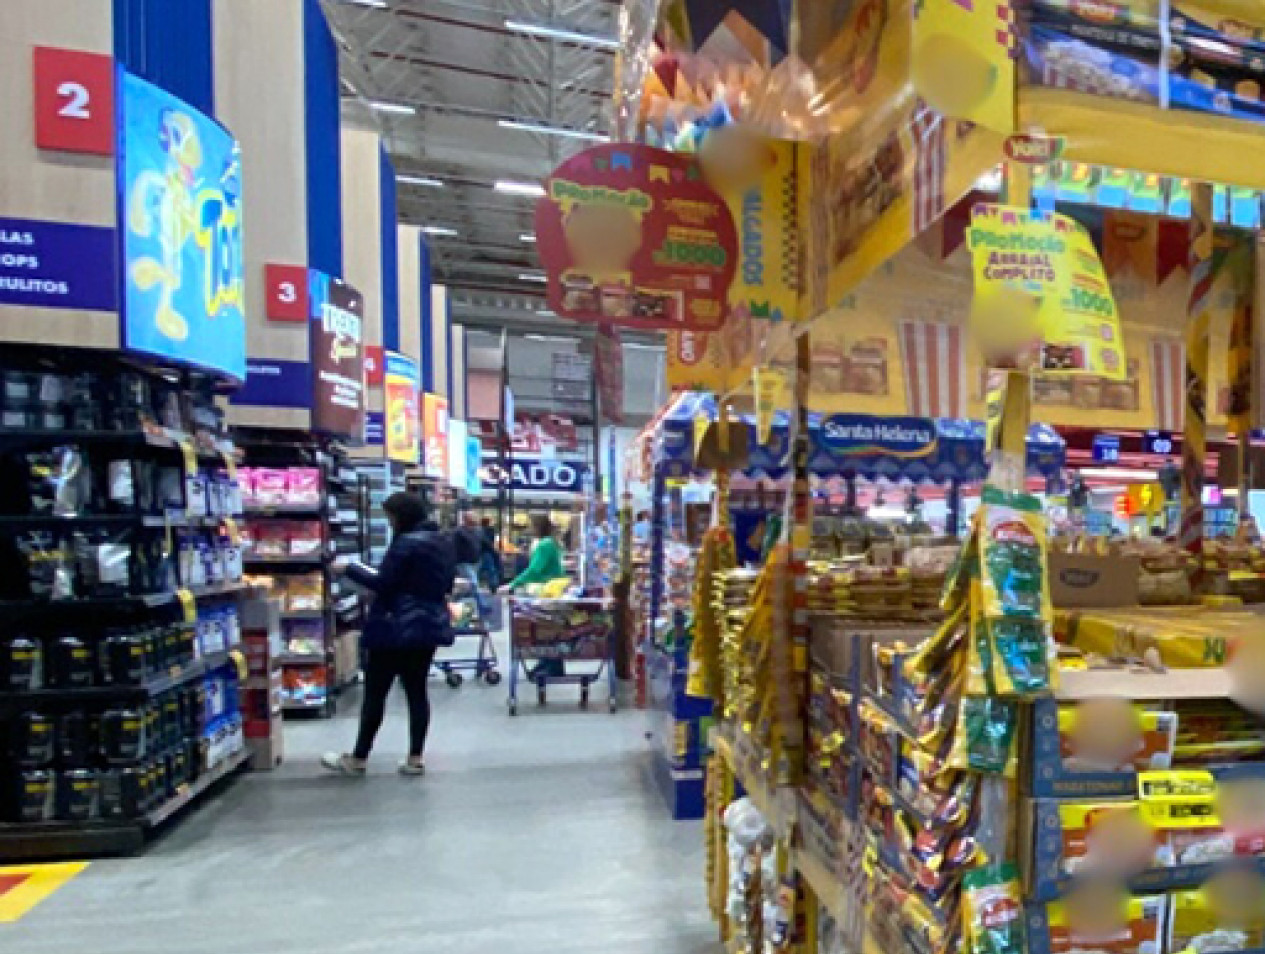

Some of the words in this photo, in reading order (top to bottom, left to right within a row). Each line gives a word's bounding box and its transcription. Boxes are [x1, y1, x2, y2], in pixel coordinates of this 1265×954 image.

[56, 81, 91, 119] 2
[277, 281, 297, 302] 3
[825, 421, 873, 440] Santa
[874, 424, 930, 443] Helena
